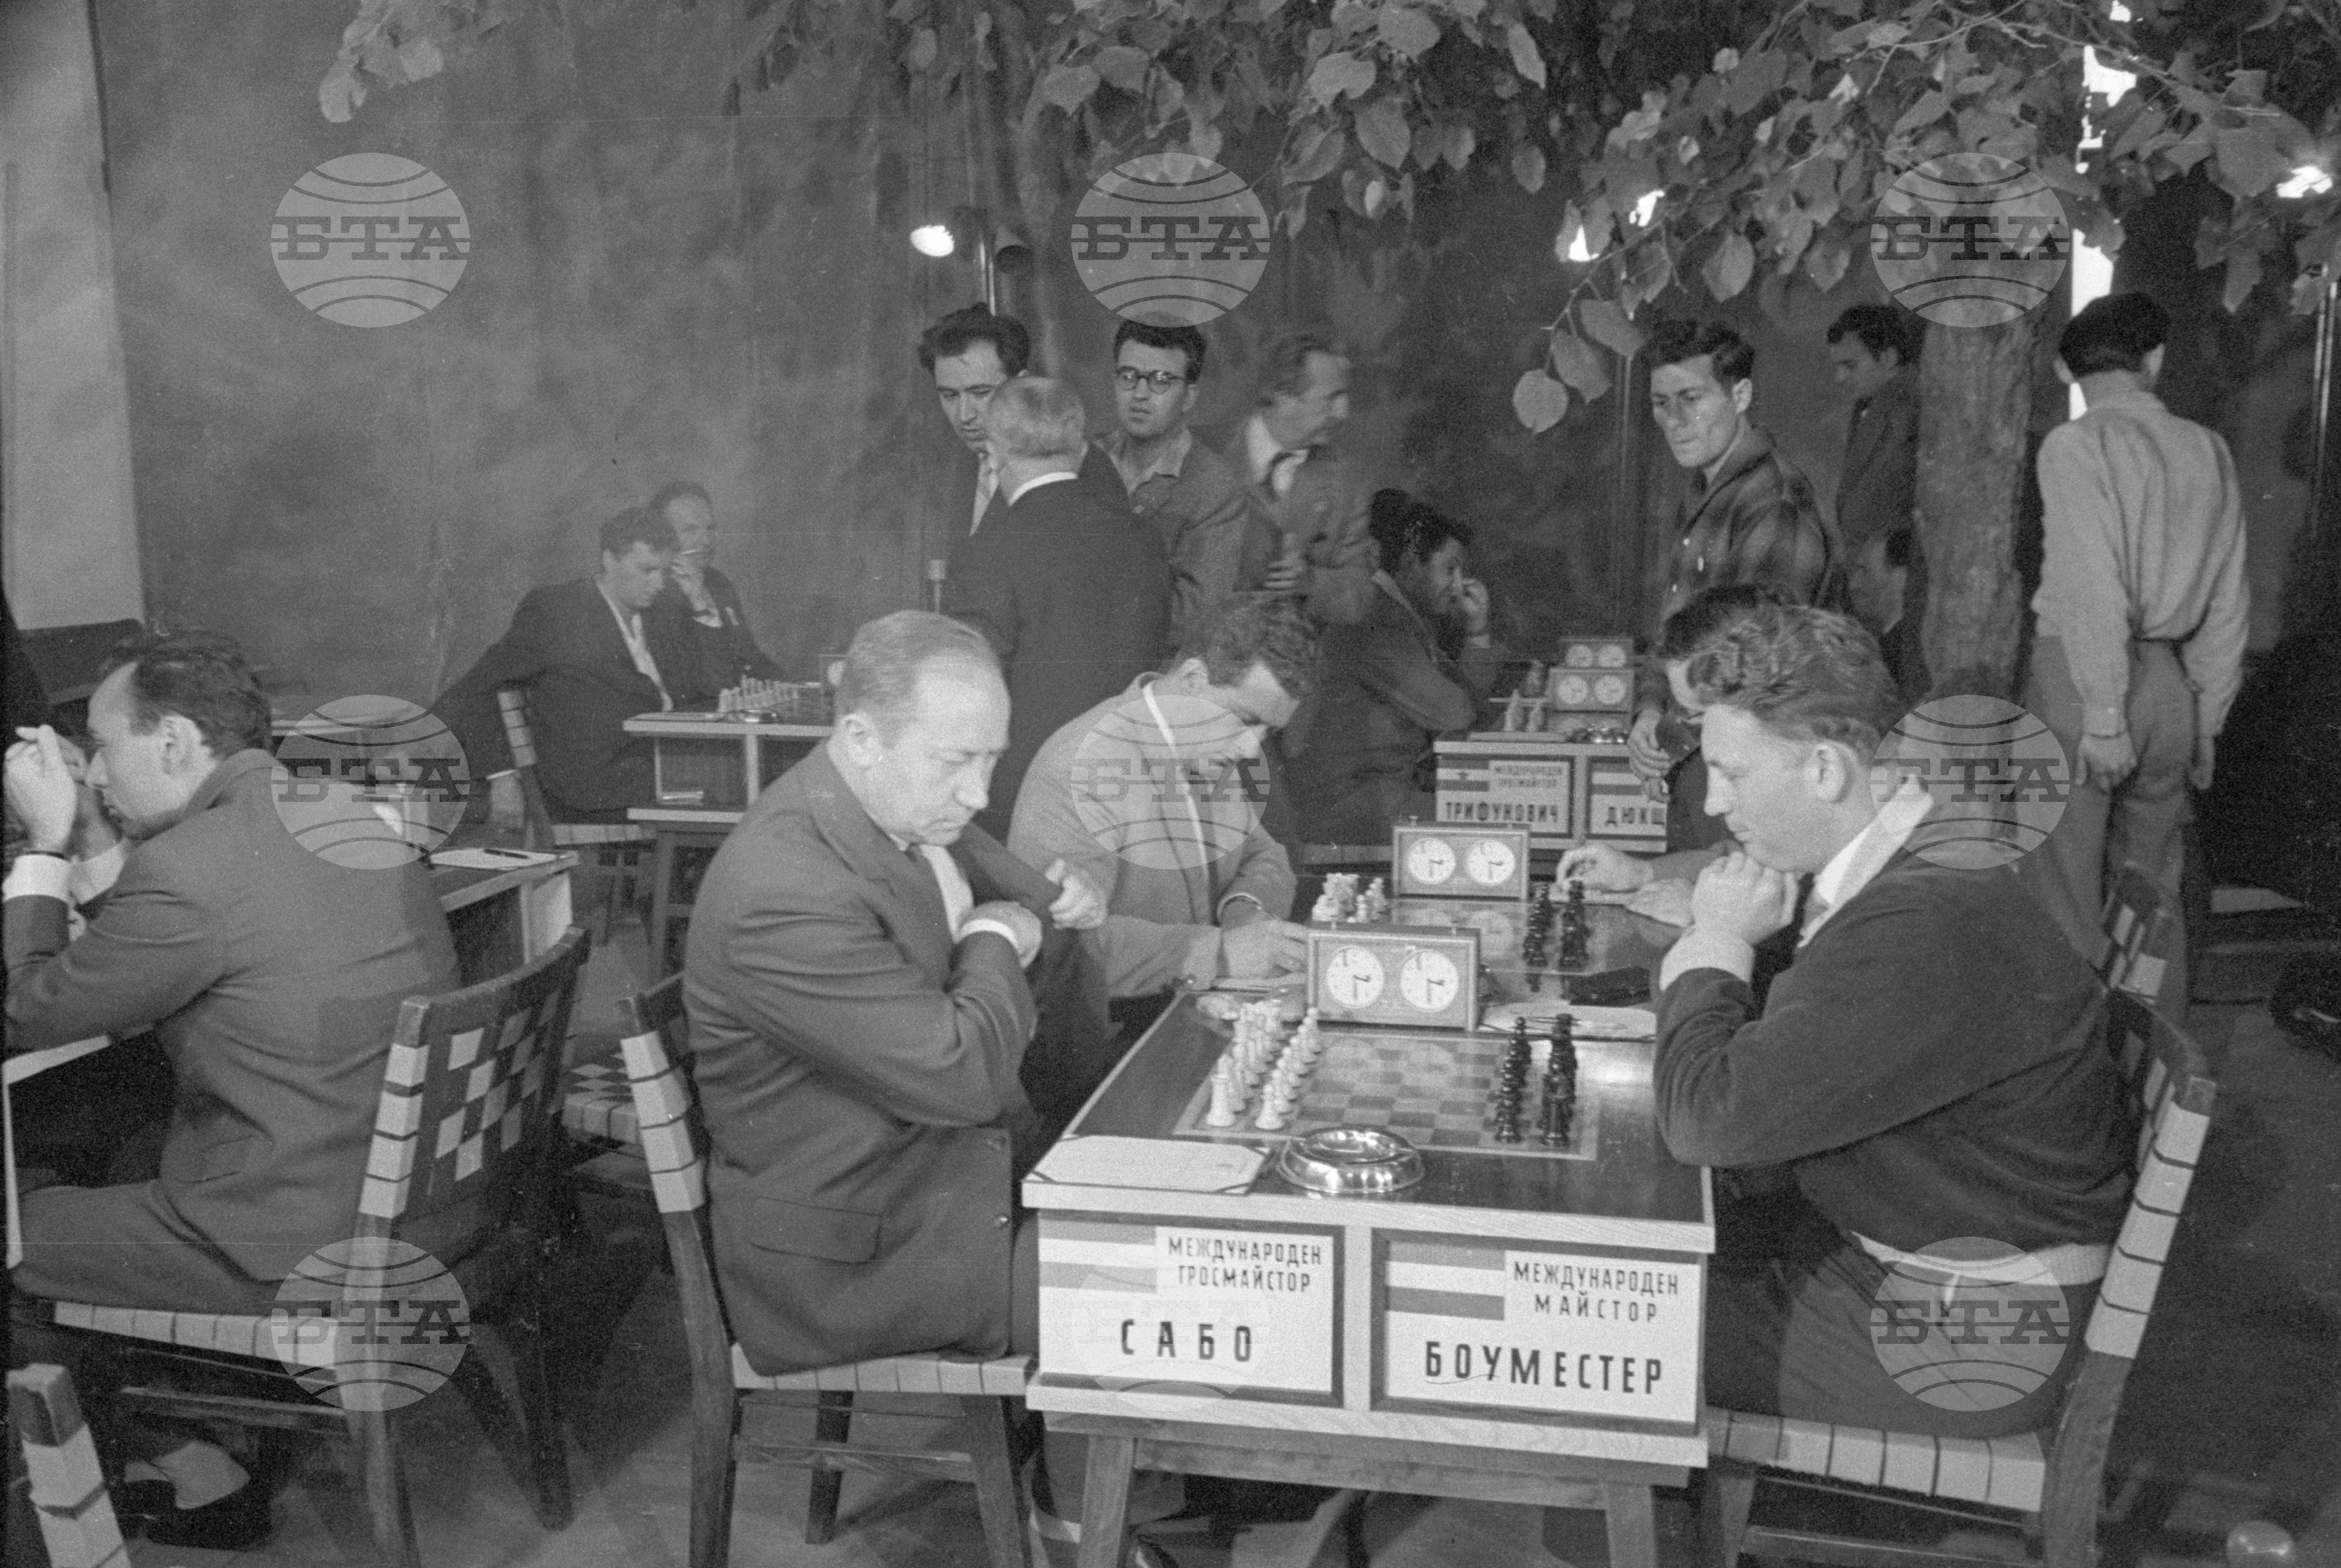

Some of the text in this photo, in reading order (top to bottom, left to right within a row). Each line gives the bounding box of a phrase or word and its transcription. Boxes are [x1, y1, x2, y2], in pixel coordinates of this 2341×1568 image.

[1446, 801, 1559, 823] ТРИФУНОВИЧ
[1168, 1236, 1322, 1268] МЕЖДУНАРОДЕН
[1179, 1264, 1311, 1292] ГРОСМАЙСТОР
[1513, 1260, 1679, 1296] МЕЖДУНАРОДЕН
[1533, 1291, 1659, 1324] МАЙСТОР
[1120, 1318, 1252, 1363] САБО
[1426, 1341, 1663, 1395] БОУМЕСТЕР
